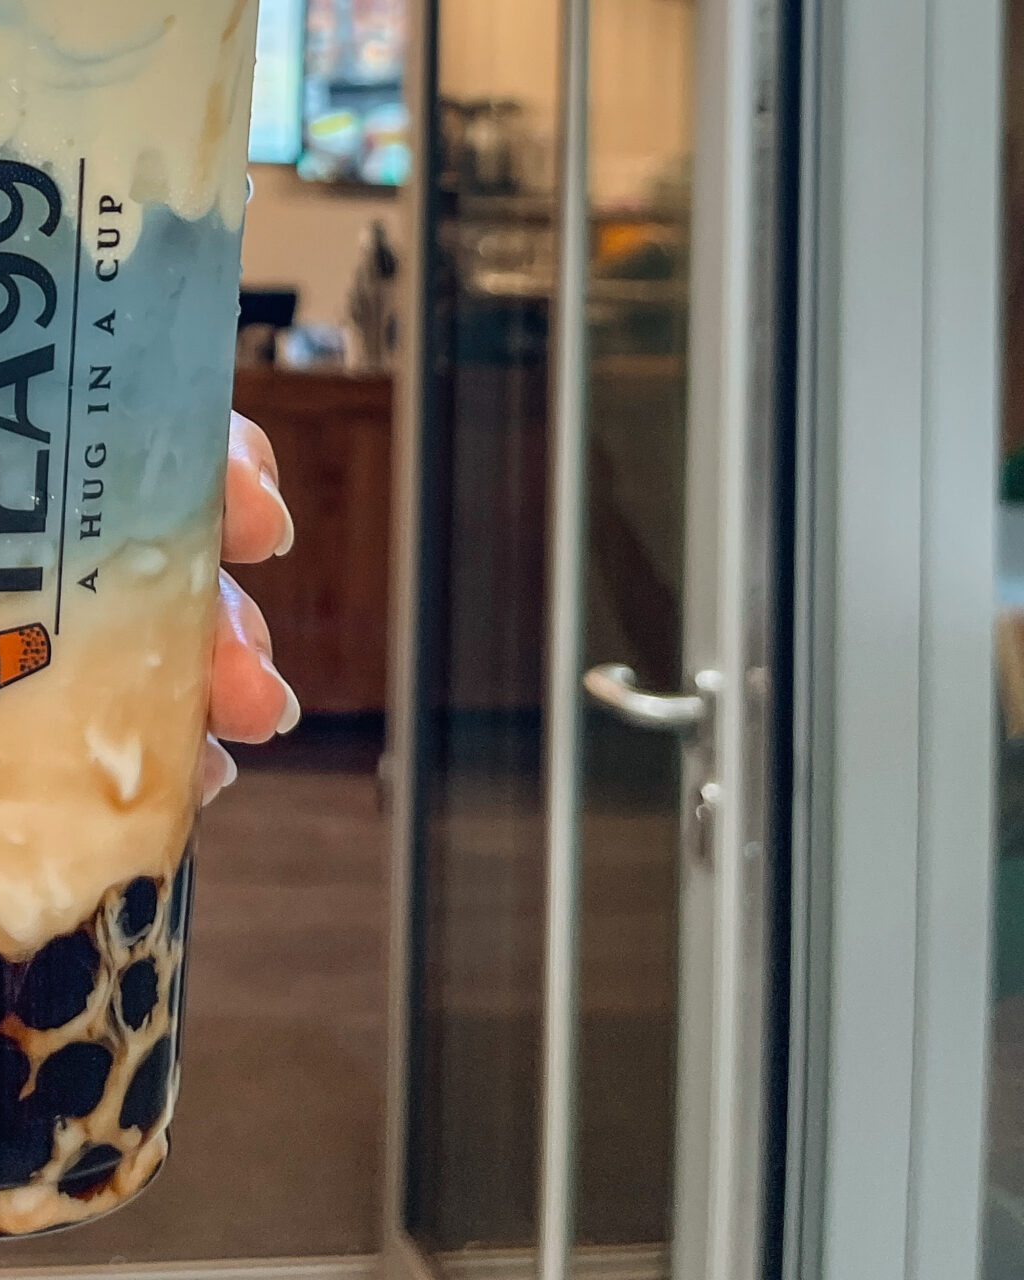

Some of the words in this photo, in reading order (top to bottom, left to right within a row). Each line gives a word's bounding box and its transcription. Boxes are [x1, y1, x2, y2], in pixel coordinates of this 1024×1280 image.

[95, 194, 124, 283] CUP
[93, 309, 116, 336] A
[88, 365, 112, 415] IN
[80, 442, 108, 540] HUG
[78, 567, 99, 593] A
